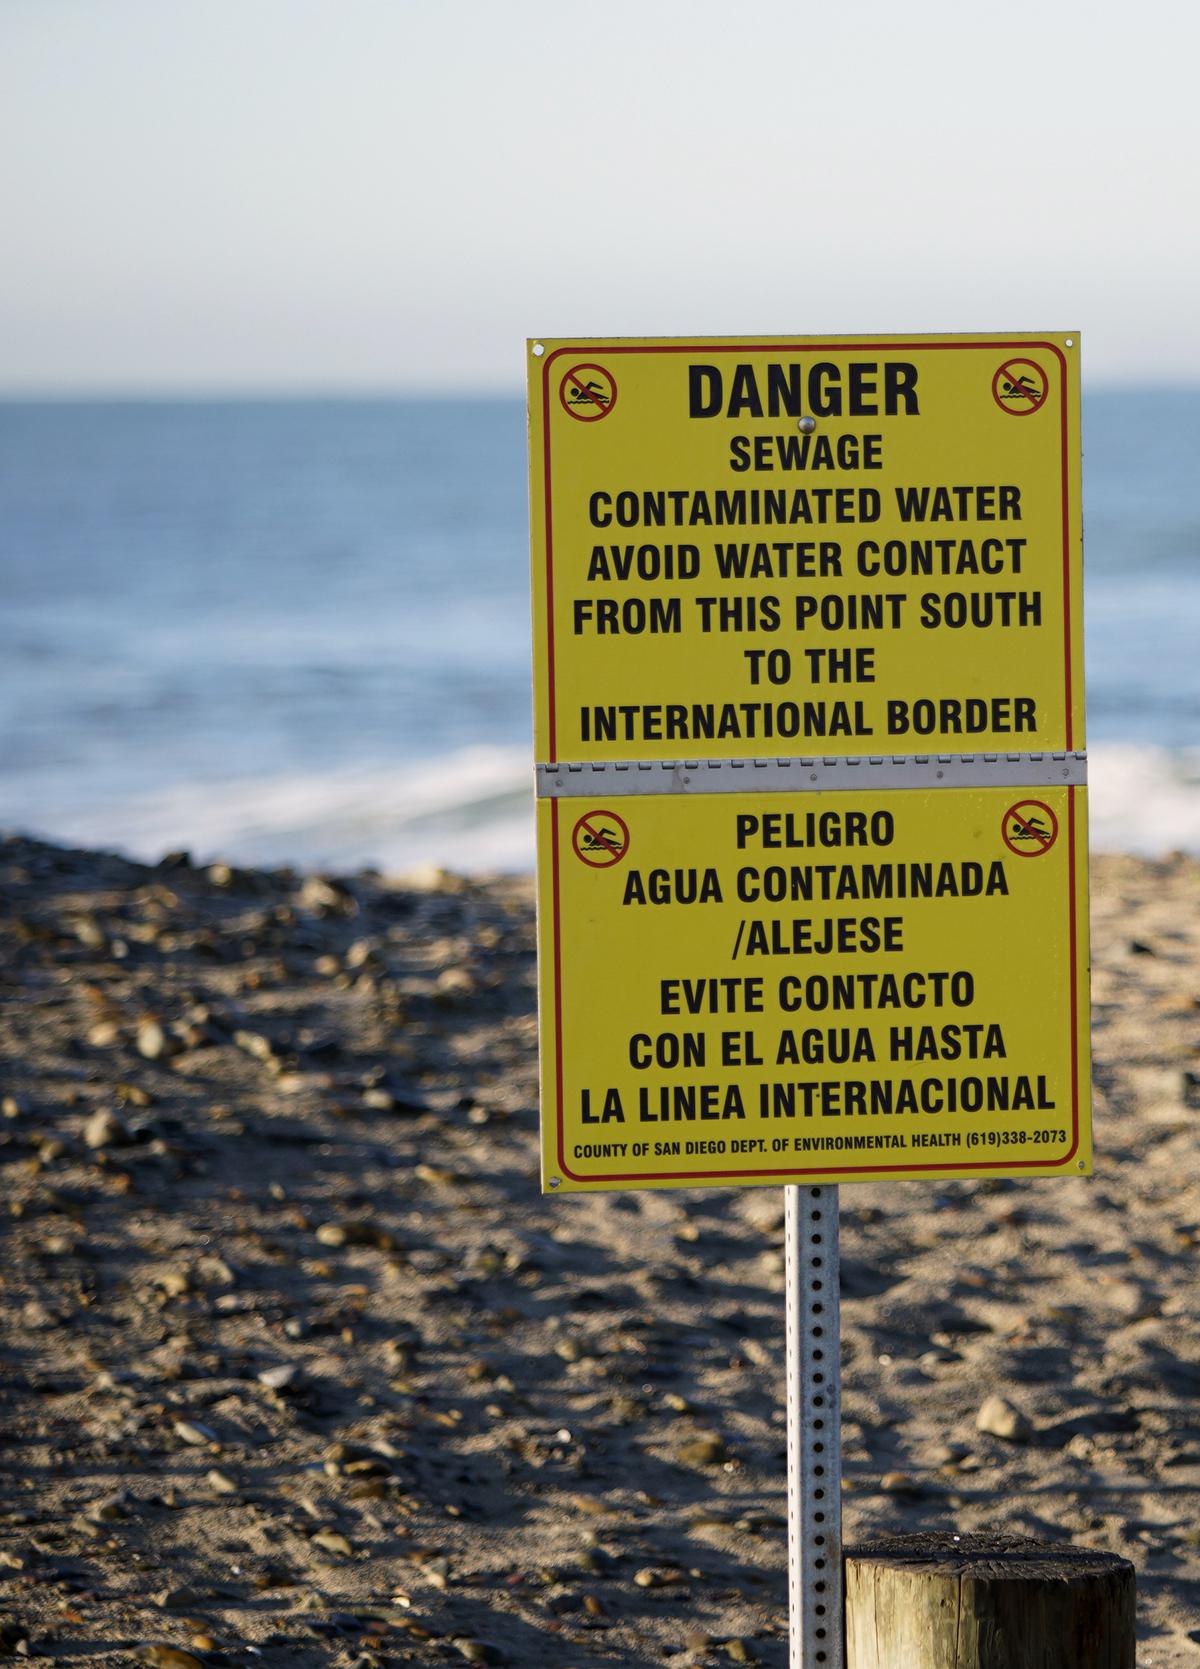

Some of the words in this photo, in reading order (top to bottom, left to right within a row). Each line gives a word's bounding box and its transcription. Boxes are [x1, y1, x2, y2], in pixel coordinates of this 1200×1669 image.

[688, 361, 922, 419] DANGER
[729, 433, 883, 473] SEWAGE
[588, 487, 881, 529] CONTAMINATED
[894, 485, 1022, 524] WATER
[586, 543, 701, 582] AVOID
[713, 540, 843, 579] WATER
[856, 537, 1027, 578] CONTACT
[573, 597, 682, 636] FROM
[695, 595, 781, 633] THIS
[795, 592, 907, 633] POINT
[920, 591, 1042, 630] SOUTH
[743, 648, 792, 686] TO
[804, 647, 876, 684] THE
[580, 698, 874, 742] INTERNATIONAL
[887, 697, 1038, 736] BORDER
[736, 810, 895, 850] PELIGRO
[622, 866, 724, 907] AGUA
[736, 860, 1010, 903] CONTAMINADA
[731, 916, 904, 961] /ALEJESE
[660, 977, 764, 1016] EVITE
[778, 970, 975, 1013] CONTACTO
[628, 1031, 706, 1070] CON
[721, 1030, 764, 1067] EL
[775, 1027, 877, 1066] AGUA
[889, 1023, 1008, 1062] HASTA
[580, 1087, 626, 1125] LA
[639, 1084, 747, 1124] LINEA
[759, 1074, 1056, 1120] INTERNACIONAL
[573, 1143, 628, 1159] COUNTY
[631, 1142, 650, 1157] OF
[654, 1141, 681, 1157] SAN
[685, 1139, 727, 1156] DIEGO
[730, 1138, 768, 1154] DEPT.
[771, 1137, 790, 1153] OF
[793, 1133, 907, 1152] ENVIRONMENTAL
[911, 1131, 962, 1148] HEALTH
[965, 1129, 1067, 1150] (619)338-2073
